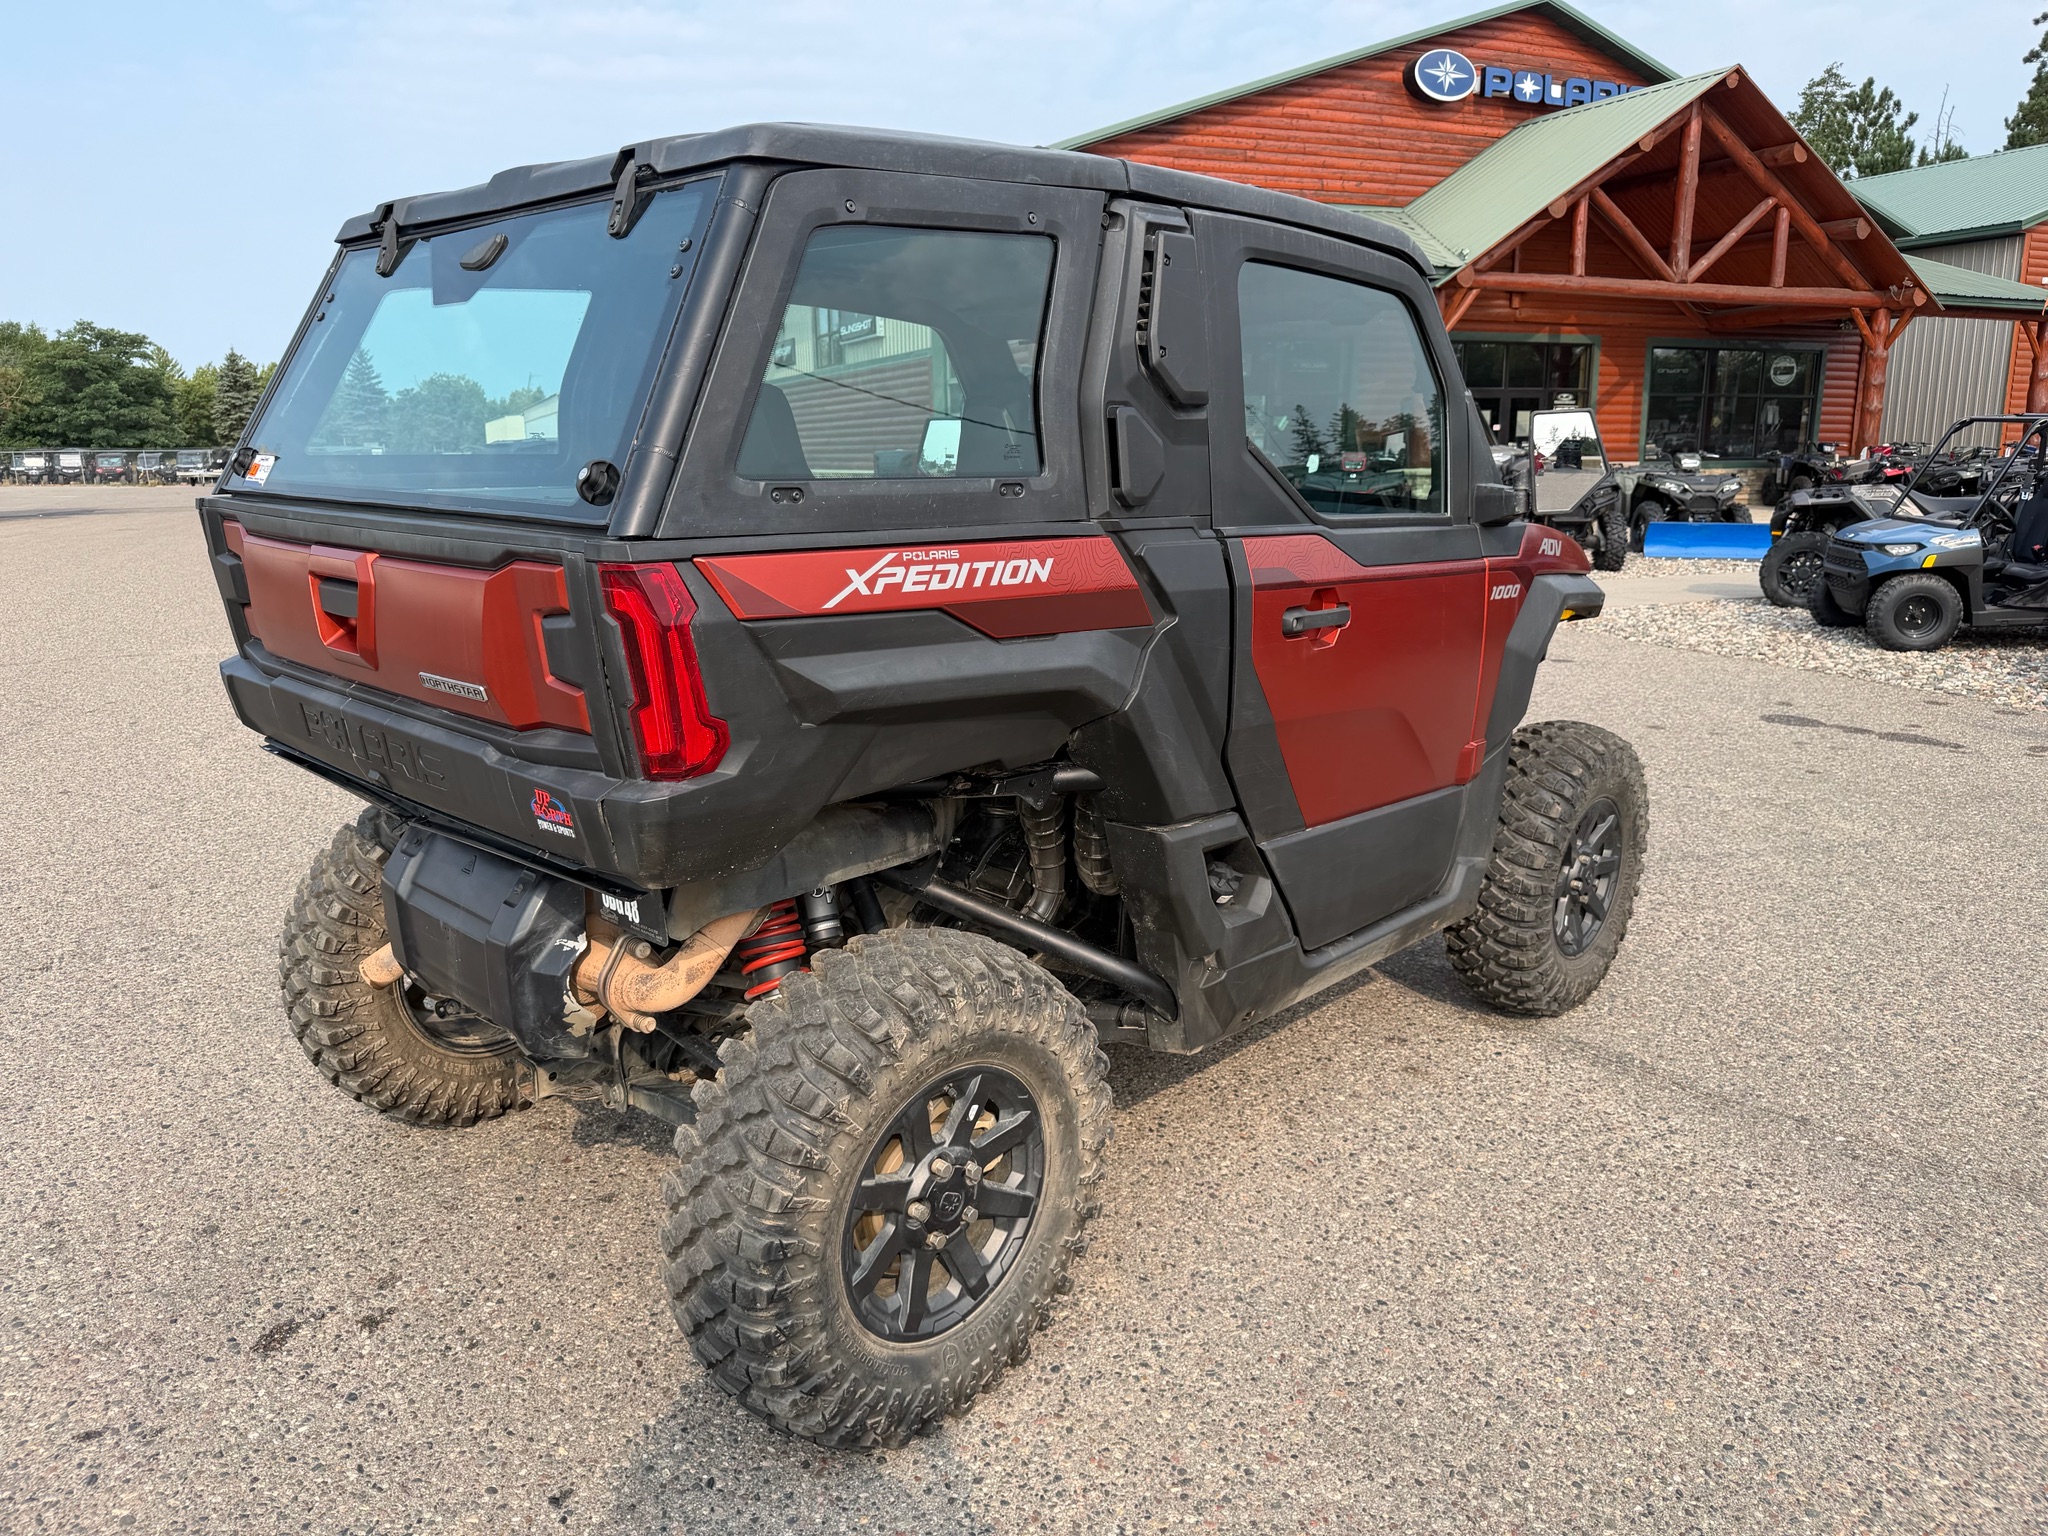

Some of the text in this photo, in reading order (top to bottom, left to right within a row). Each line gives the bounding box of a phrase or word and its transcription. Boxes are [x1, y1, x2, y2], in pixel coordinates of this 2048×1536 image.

[1482, 66, 1646, 107] POLAR
[902, 549, 960, 562] POLARIS
[1538, 537, 1562, 556] ADV
[821, 552, 1054, 609] XPEDITION
[1490, 584, 1520, 600] 1000
[421, 676, 482, 700] NORTHSTAR
[298, 702, 448, 791] POLARIS
[534, 788, 550, 807] UP
[532, 803, 573, 827] NORTH
[963, 1241, 1052, 1355] PRO ARMOR
